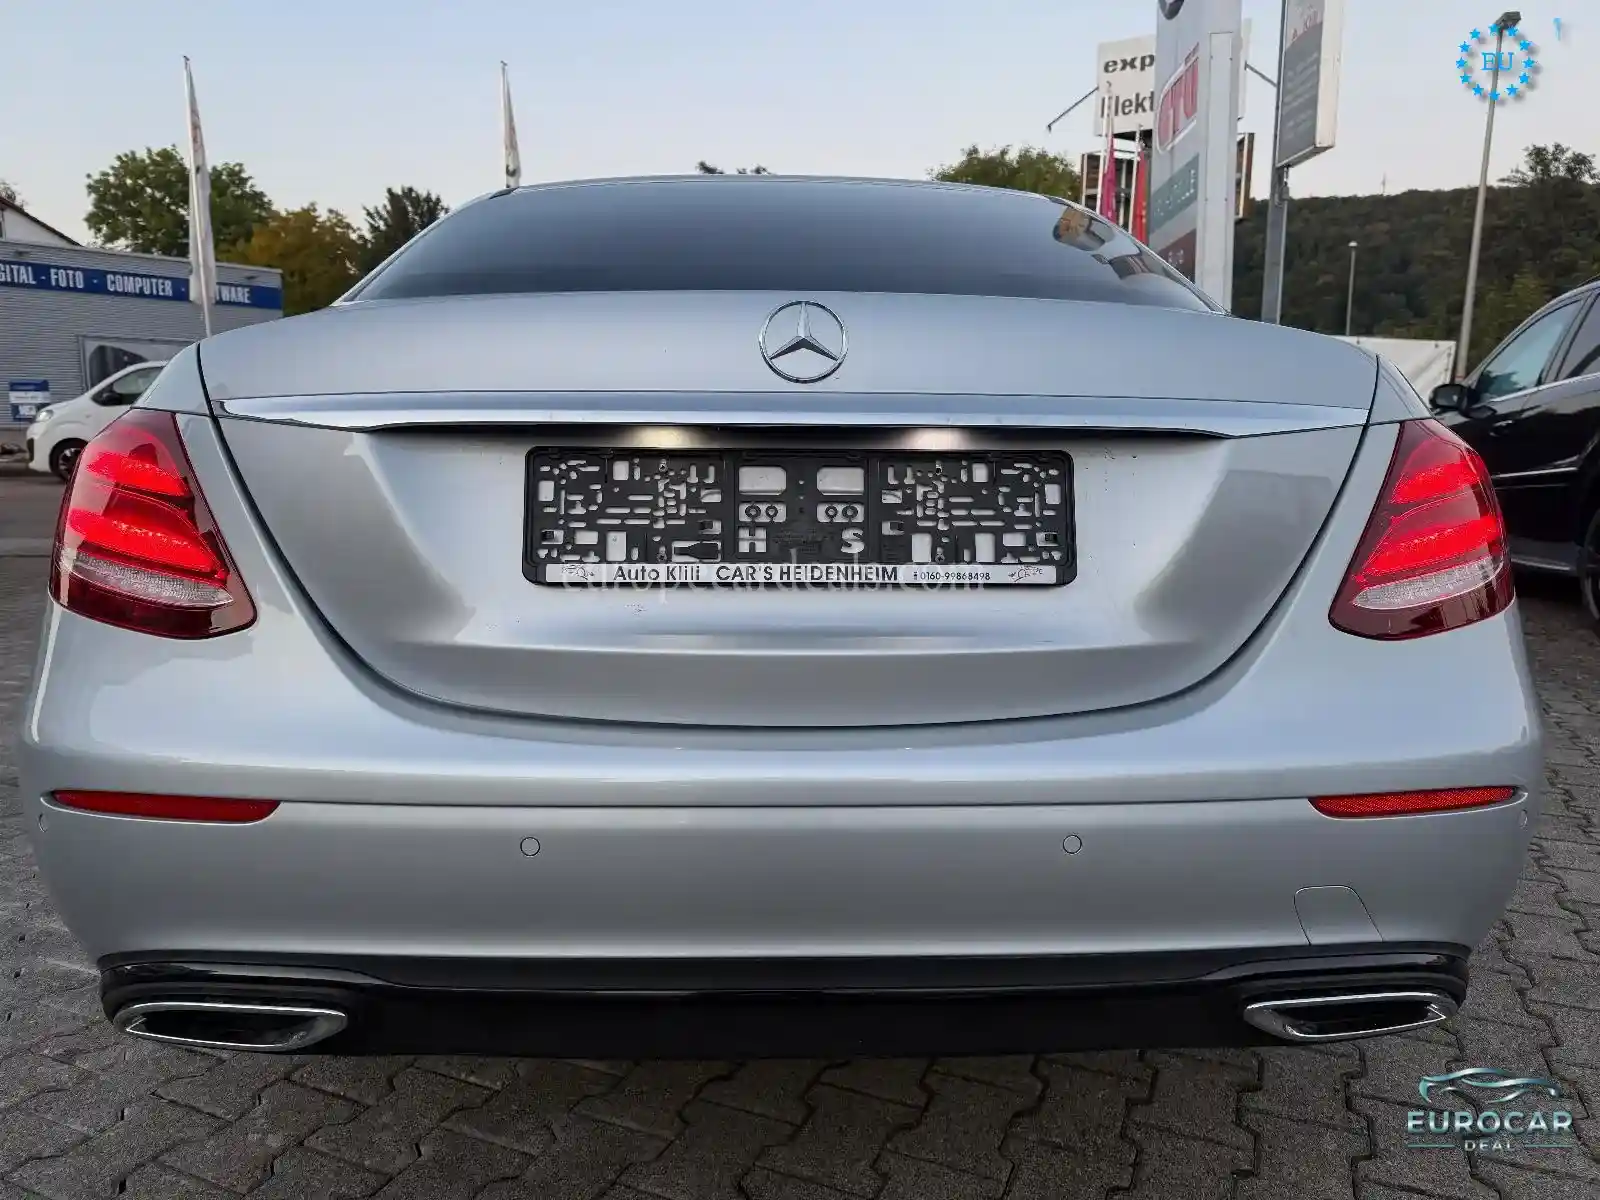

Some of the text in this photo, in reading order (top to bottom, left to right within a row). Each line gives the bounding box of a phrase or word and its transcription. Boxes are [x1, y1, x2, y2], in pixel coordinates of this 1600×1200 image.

[50, 267, 84, 289] FOTO
[106, 274, 173, 297] COMPUTER
[613, 565, 660, 581] Auto
[716, 565, 773, 581] CAR'S
[779, 565, 898, 582] HEIDENHEIM
